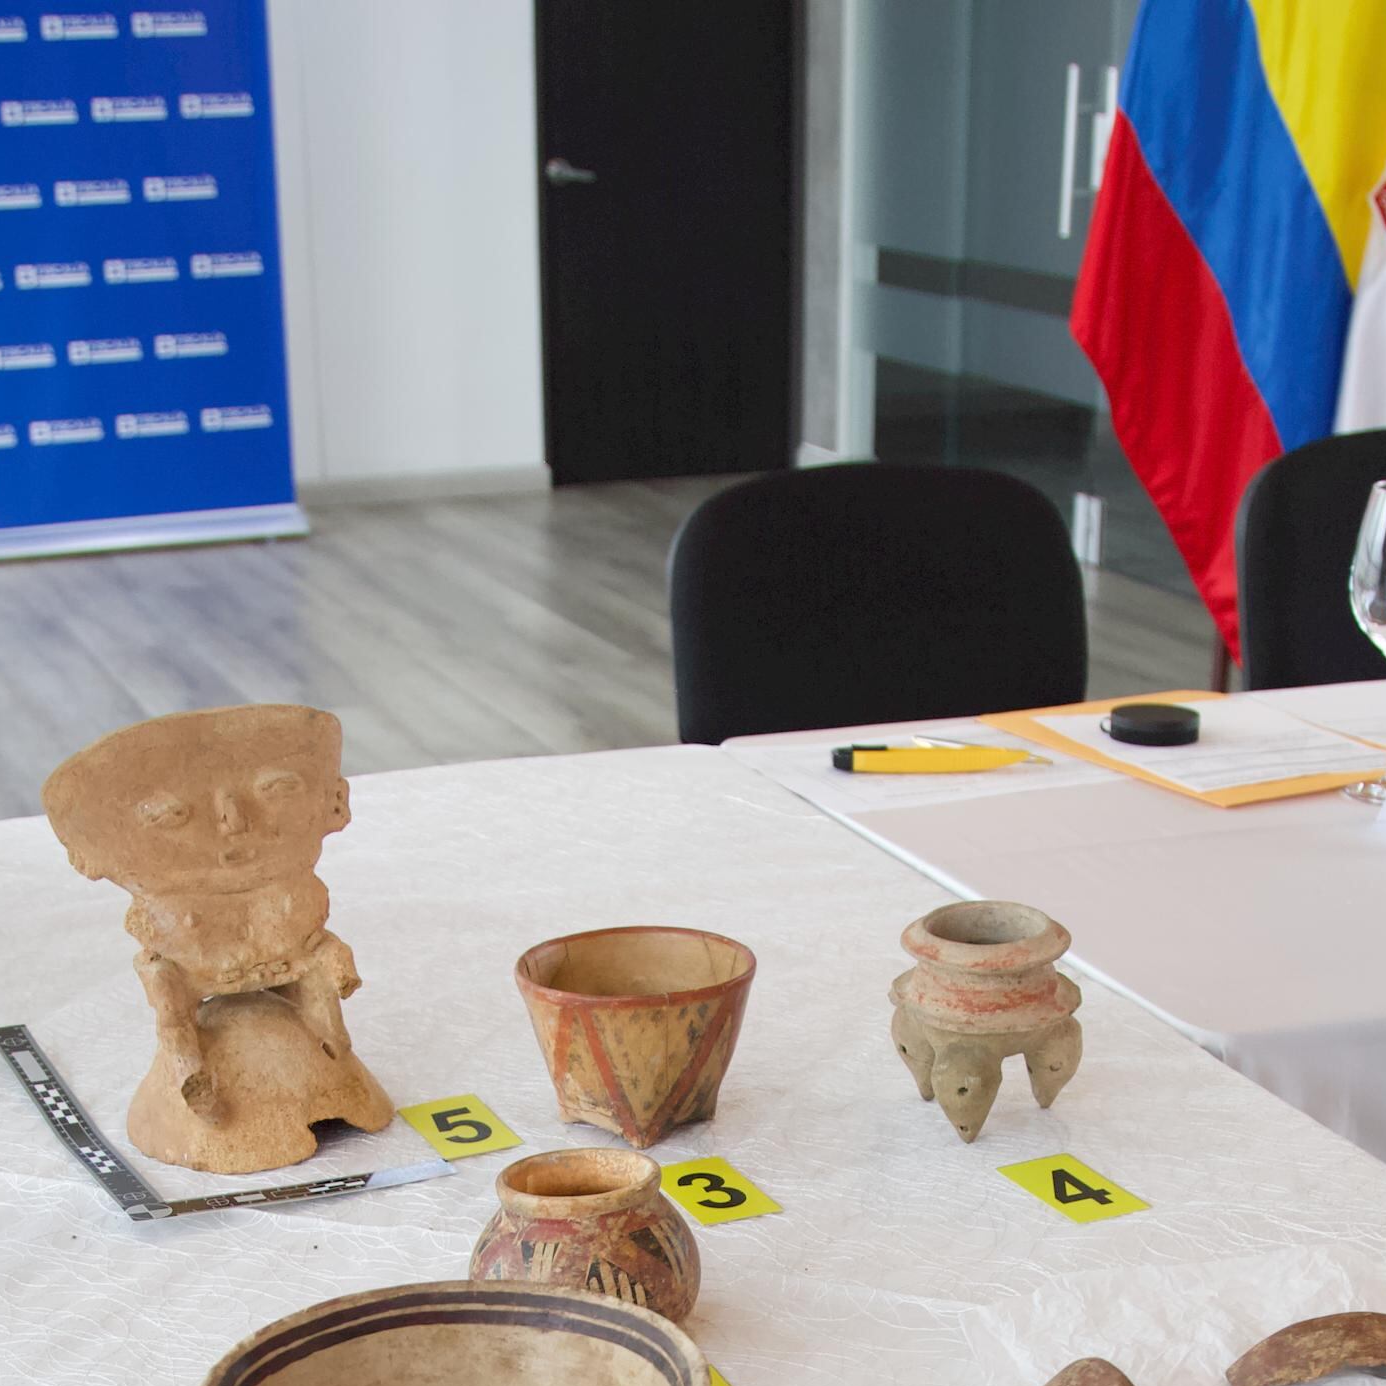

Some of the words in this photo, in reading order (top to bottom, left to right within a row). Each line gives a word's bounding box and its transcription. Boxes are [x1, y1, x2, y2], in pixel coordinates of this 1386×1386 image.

[431, 1107, 492, 1143] 5
[677, 1172, 747, 1209] 3
[1052, 1169, 1113, 1205] 4
